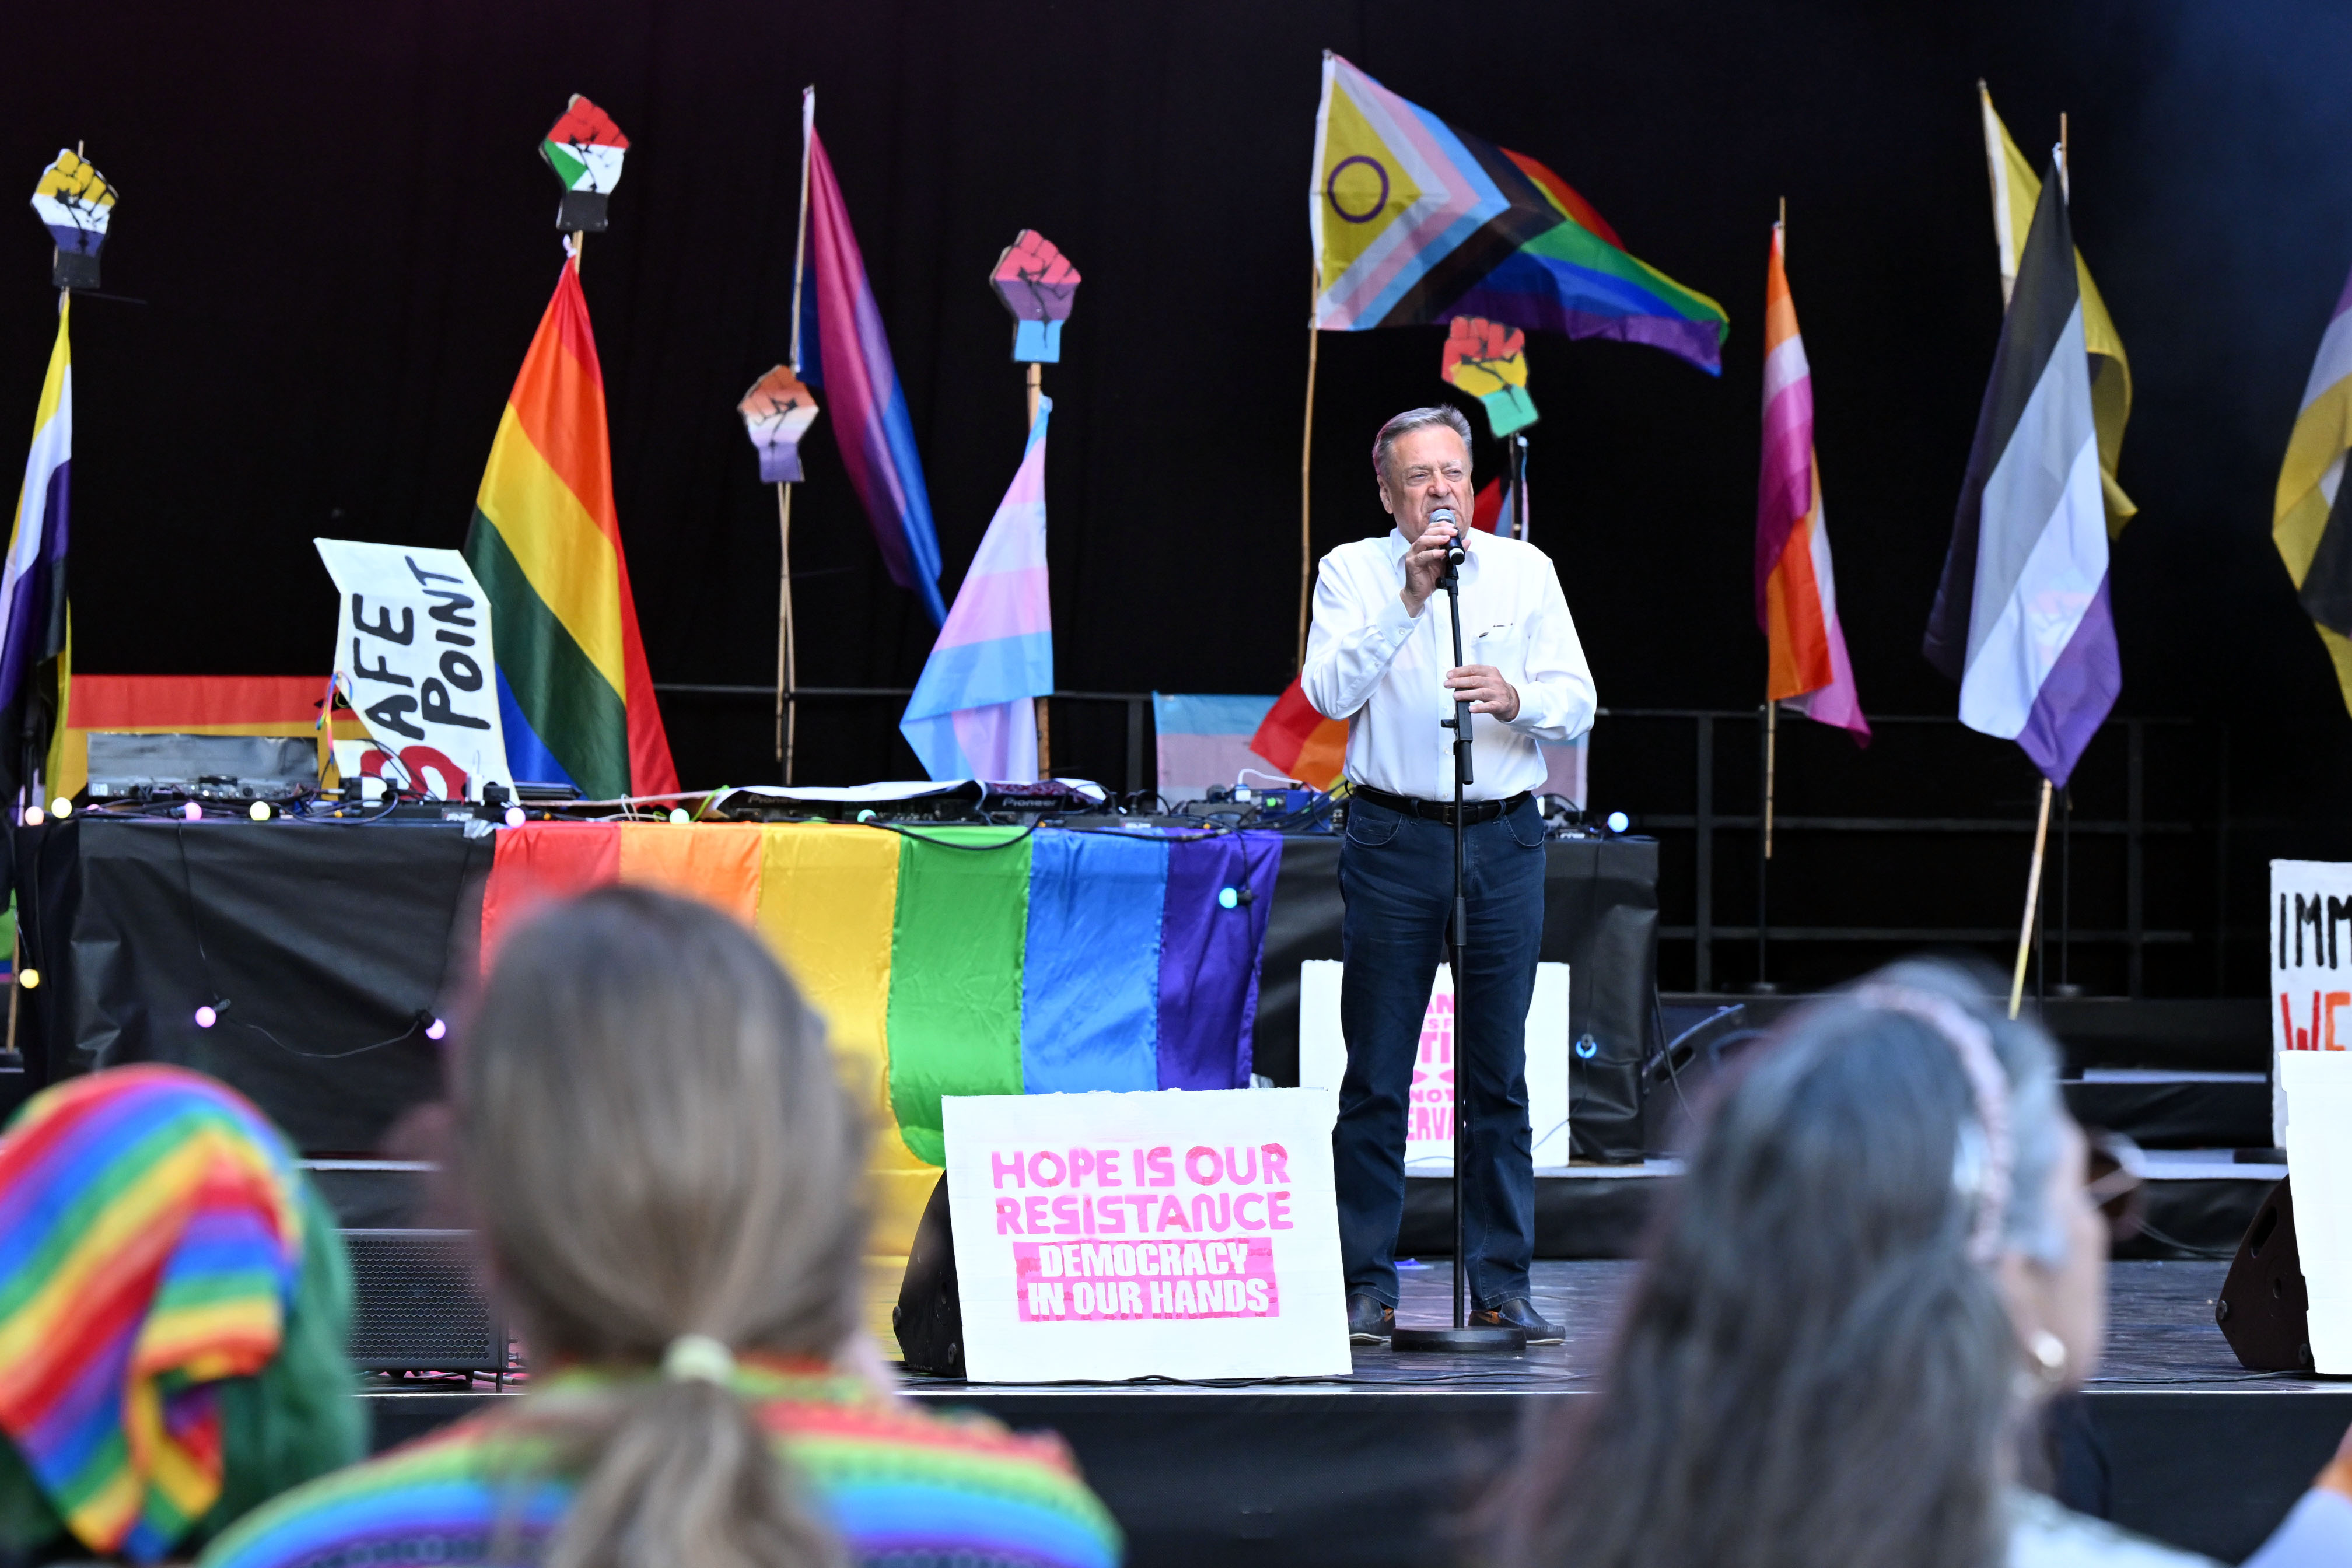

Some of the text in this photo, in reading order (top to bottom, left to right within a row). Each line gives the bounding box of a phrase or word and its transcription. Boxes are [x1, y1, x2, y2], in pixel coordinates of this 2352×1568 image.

[405, 555, 491, 730] POINT
[991, 1142, 1291, 1189] HOPE IS OUR
[996, 1191, 1293, 1235] RESISTANCE
[1040, 1242, 1248, 1278] DEMOCRACY
[1028, 1278, 1269, 1316] IN OUR HANDS
